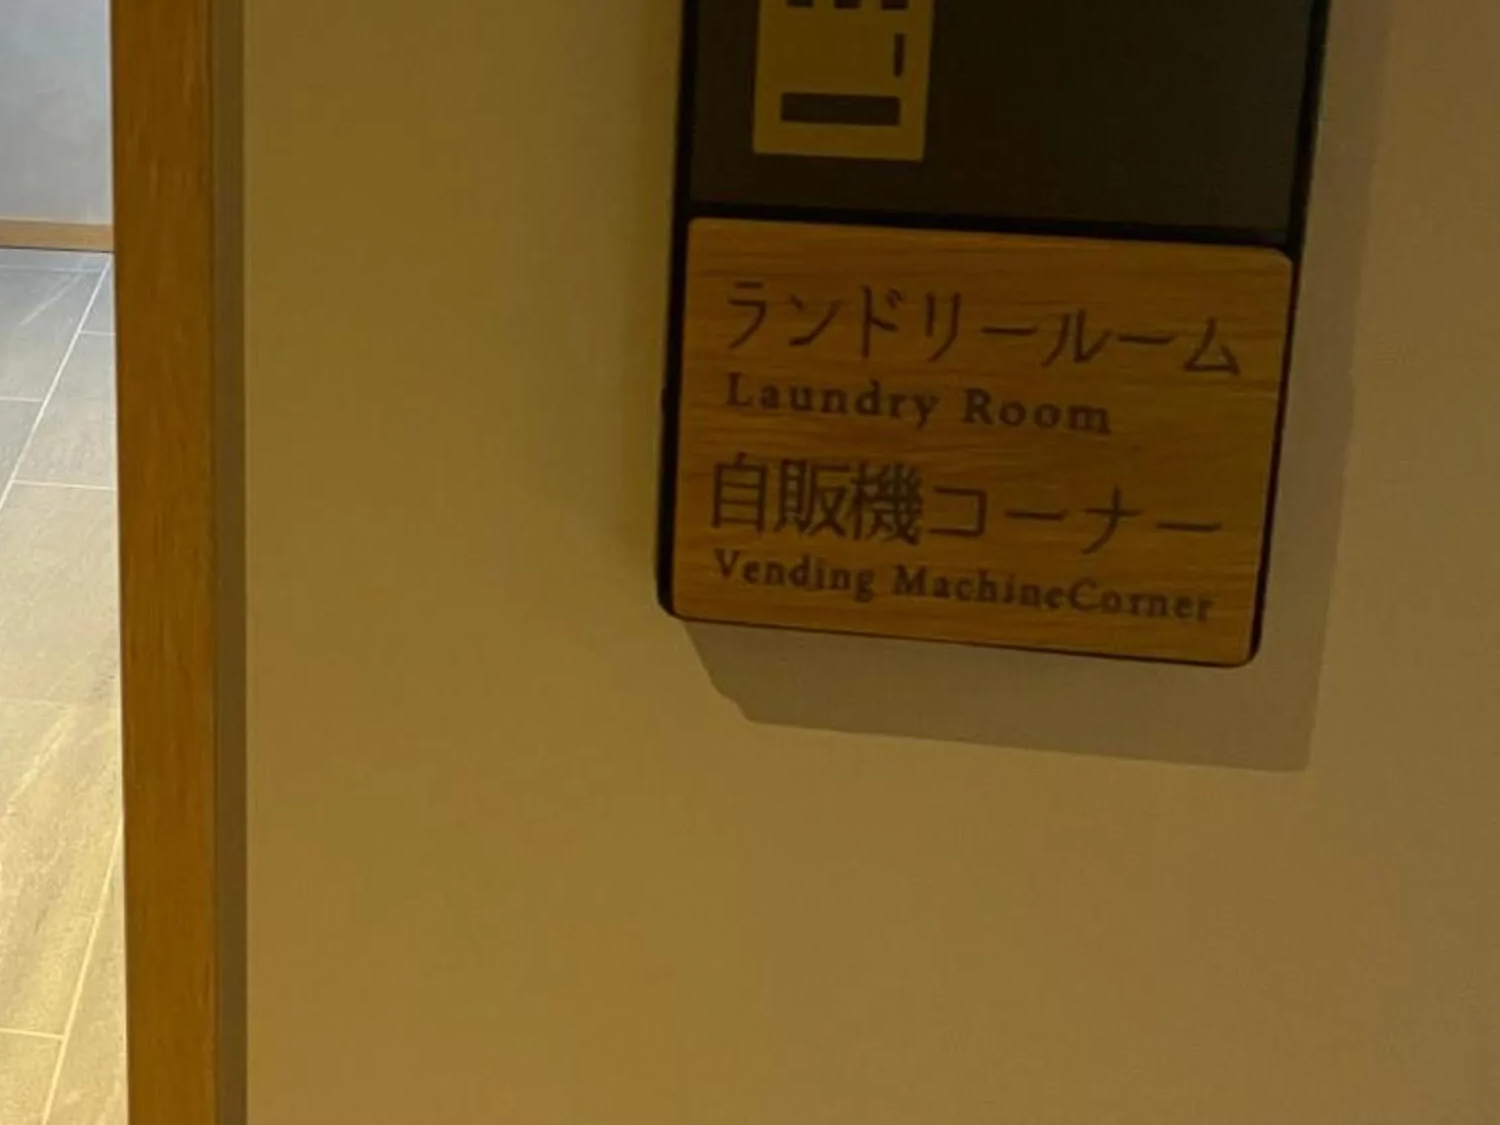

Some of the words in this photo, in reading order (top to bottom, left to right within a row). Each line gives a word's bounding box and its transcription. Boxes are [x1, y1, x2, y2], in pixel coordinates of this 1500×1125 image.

[728, 280, 1242, 376] ランドリールーム
[725, 372, 940, 429] Laundry
[961, 387, 1113, 435] Room
[710, 452, 1224, 555] 自販機コーナー
[714, 549, 876, 602] Vending
[892, 565, 1216, 622] MachineCorner
